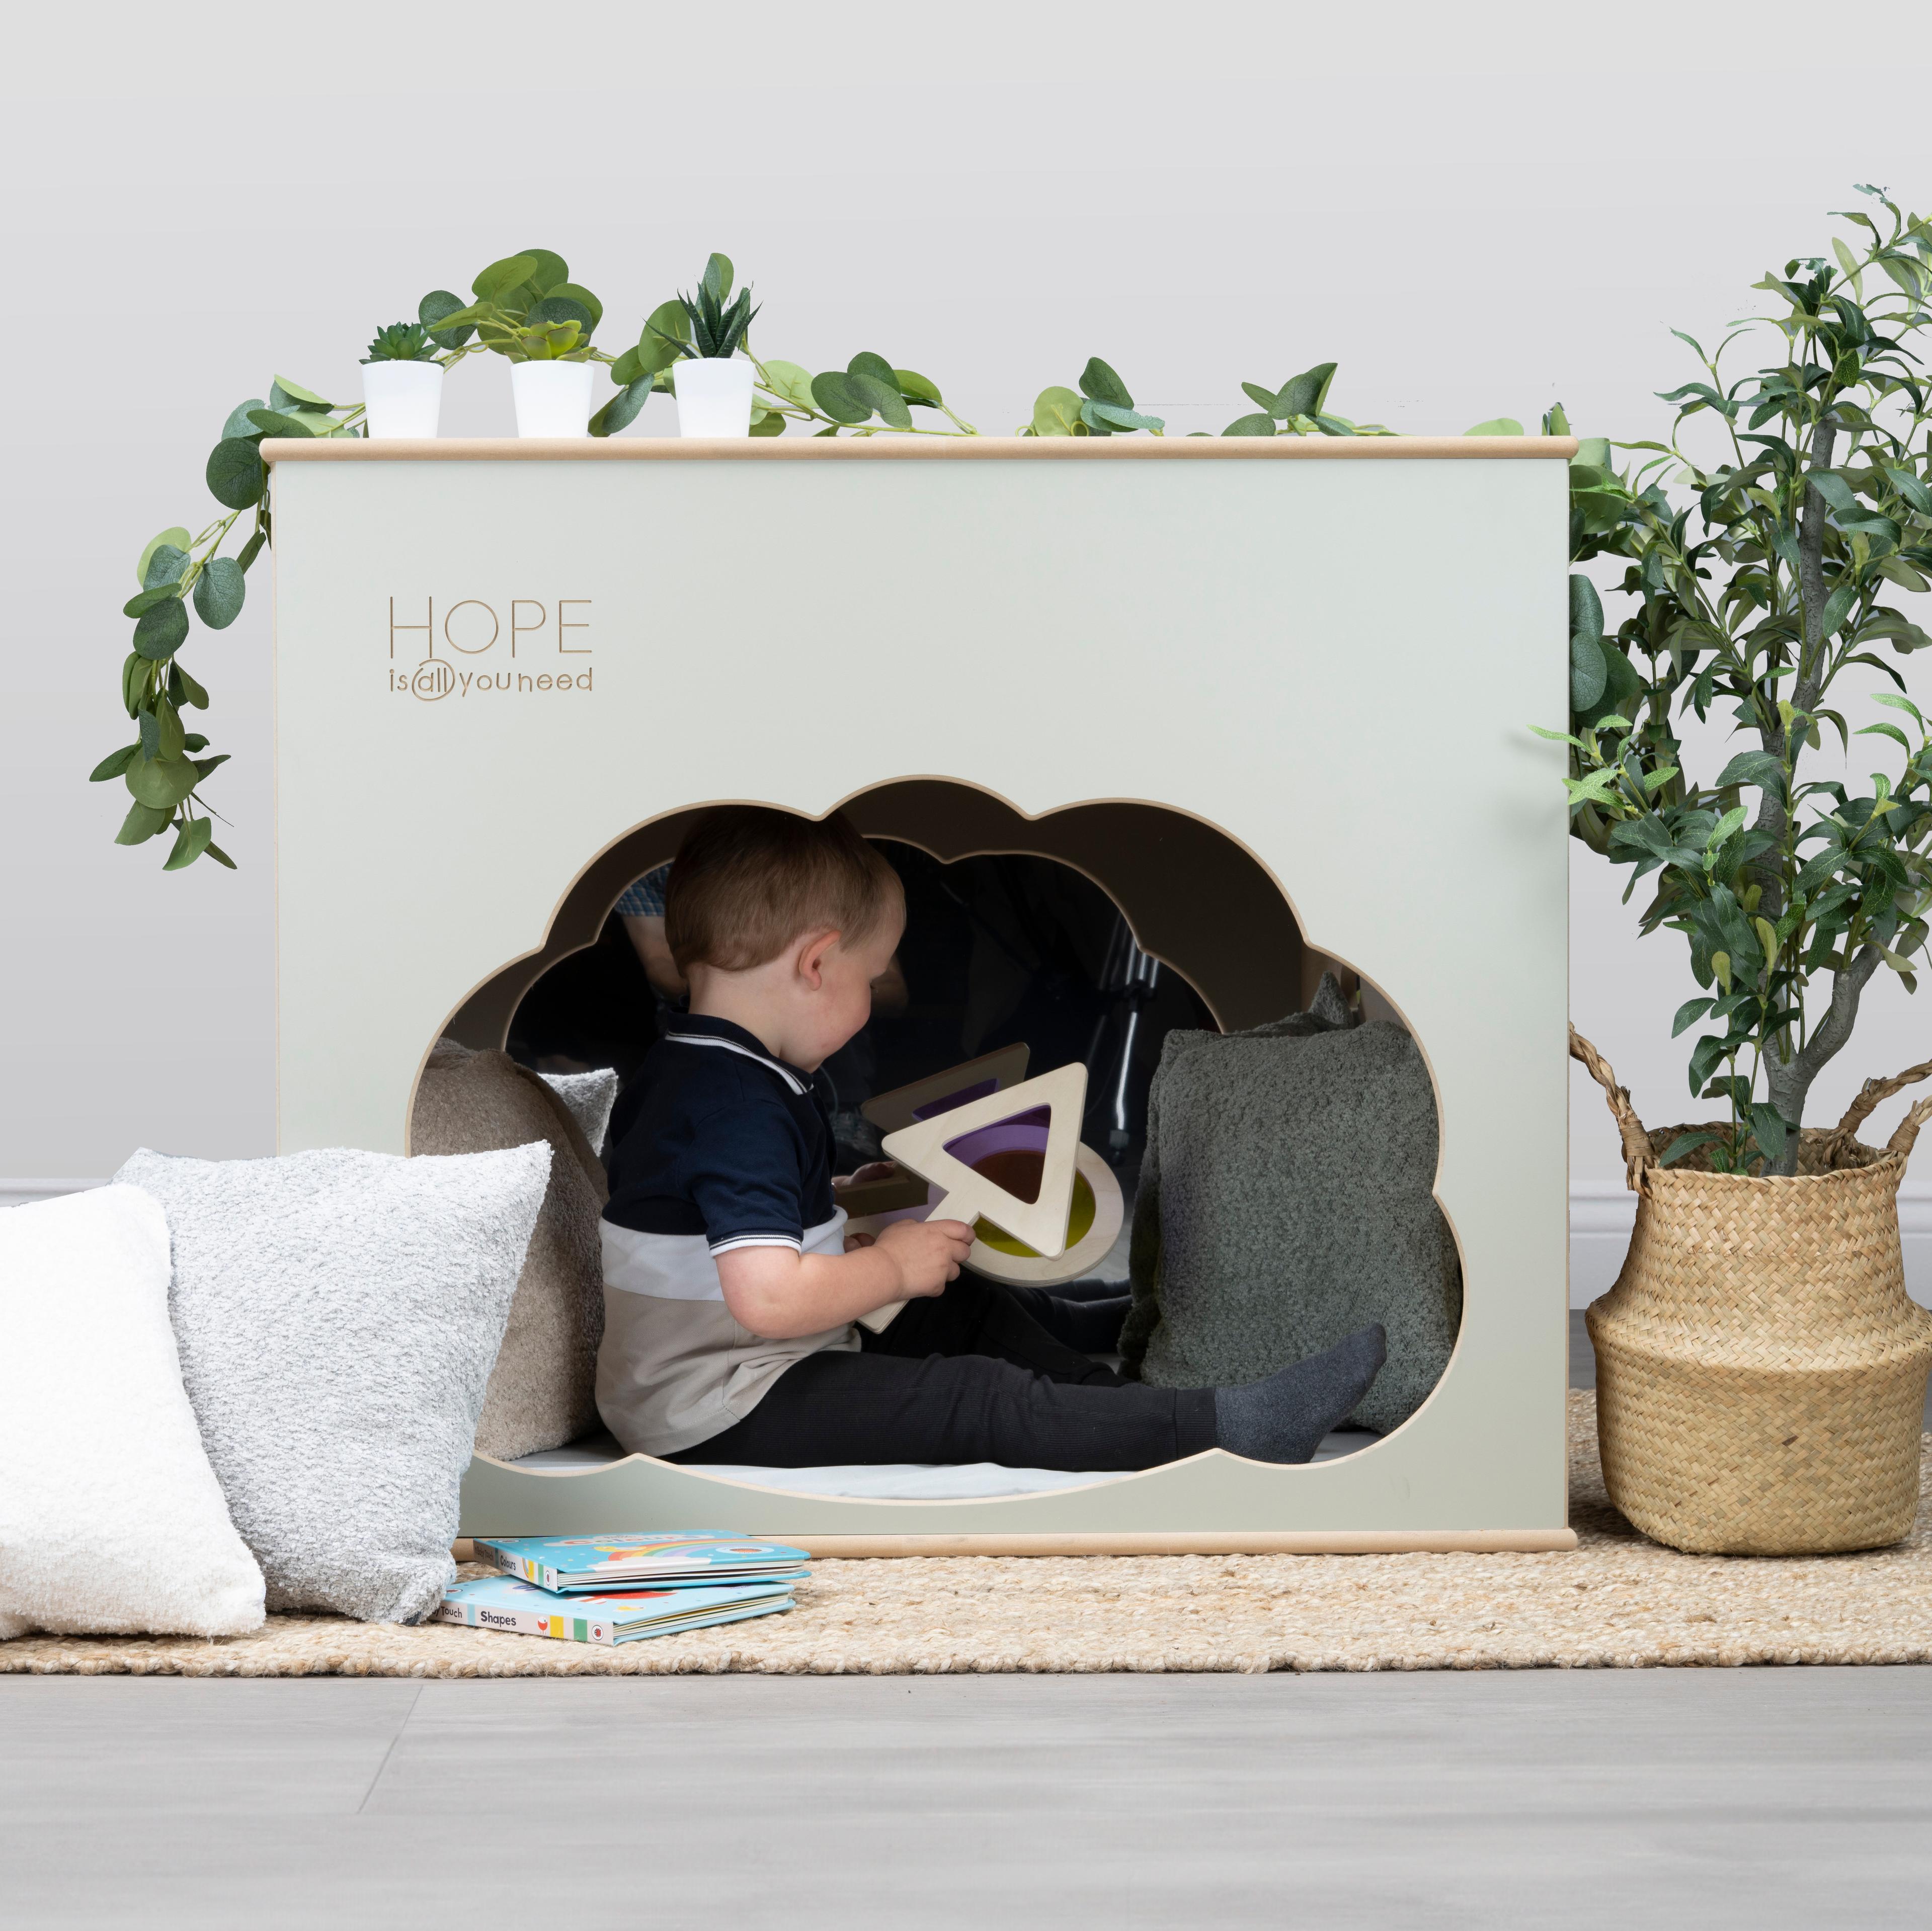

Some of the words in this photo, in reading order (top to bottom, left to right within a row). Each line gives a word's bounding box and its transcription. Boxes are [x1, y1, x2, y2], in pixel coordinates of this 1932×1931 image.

[390, 596, 593, 659] HOPE
[389, 668, 408, 692] is
[417, 667, 448, 693] all
[459, 671, 512, 698] you
[518, 667, 593, 693] need
[500, 1555, 516, 1571] Colours
[440, 1606, 462, 1618] Touch
[480, 1611, 517, 1627] Shapes
